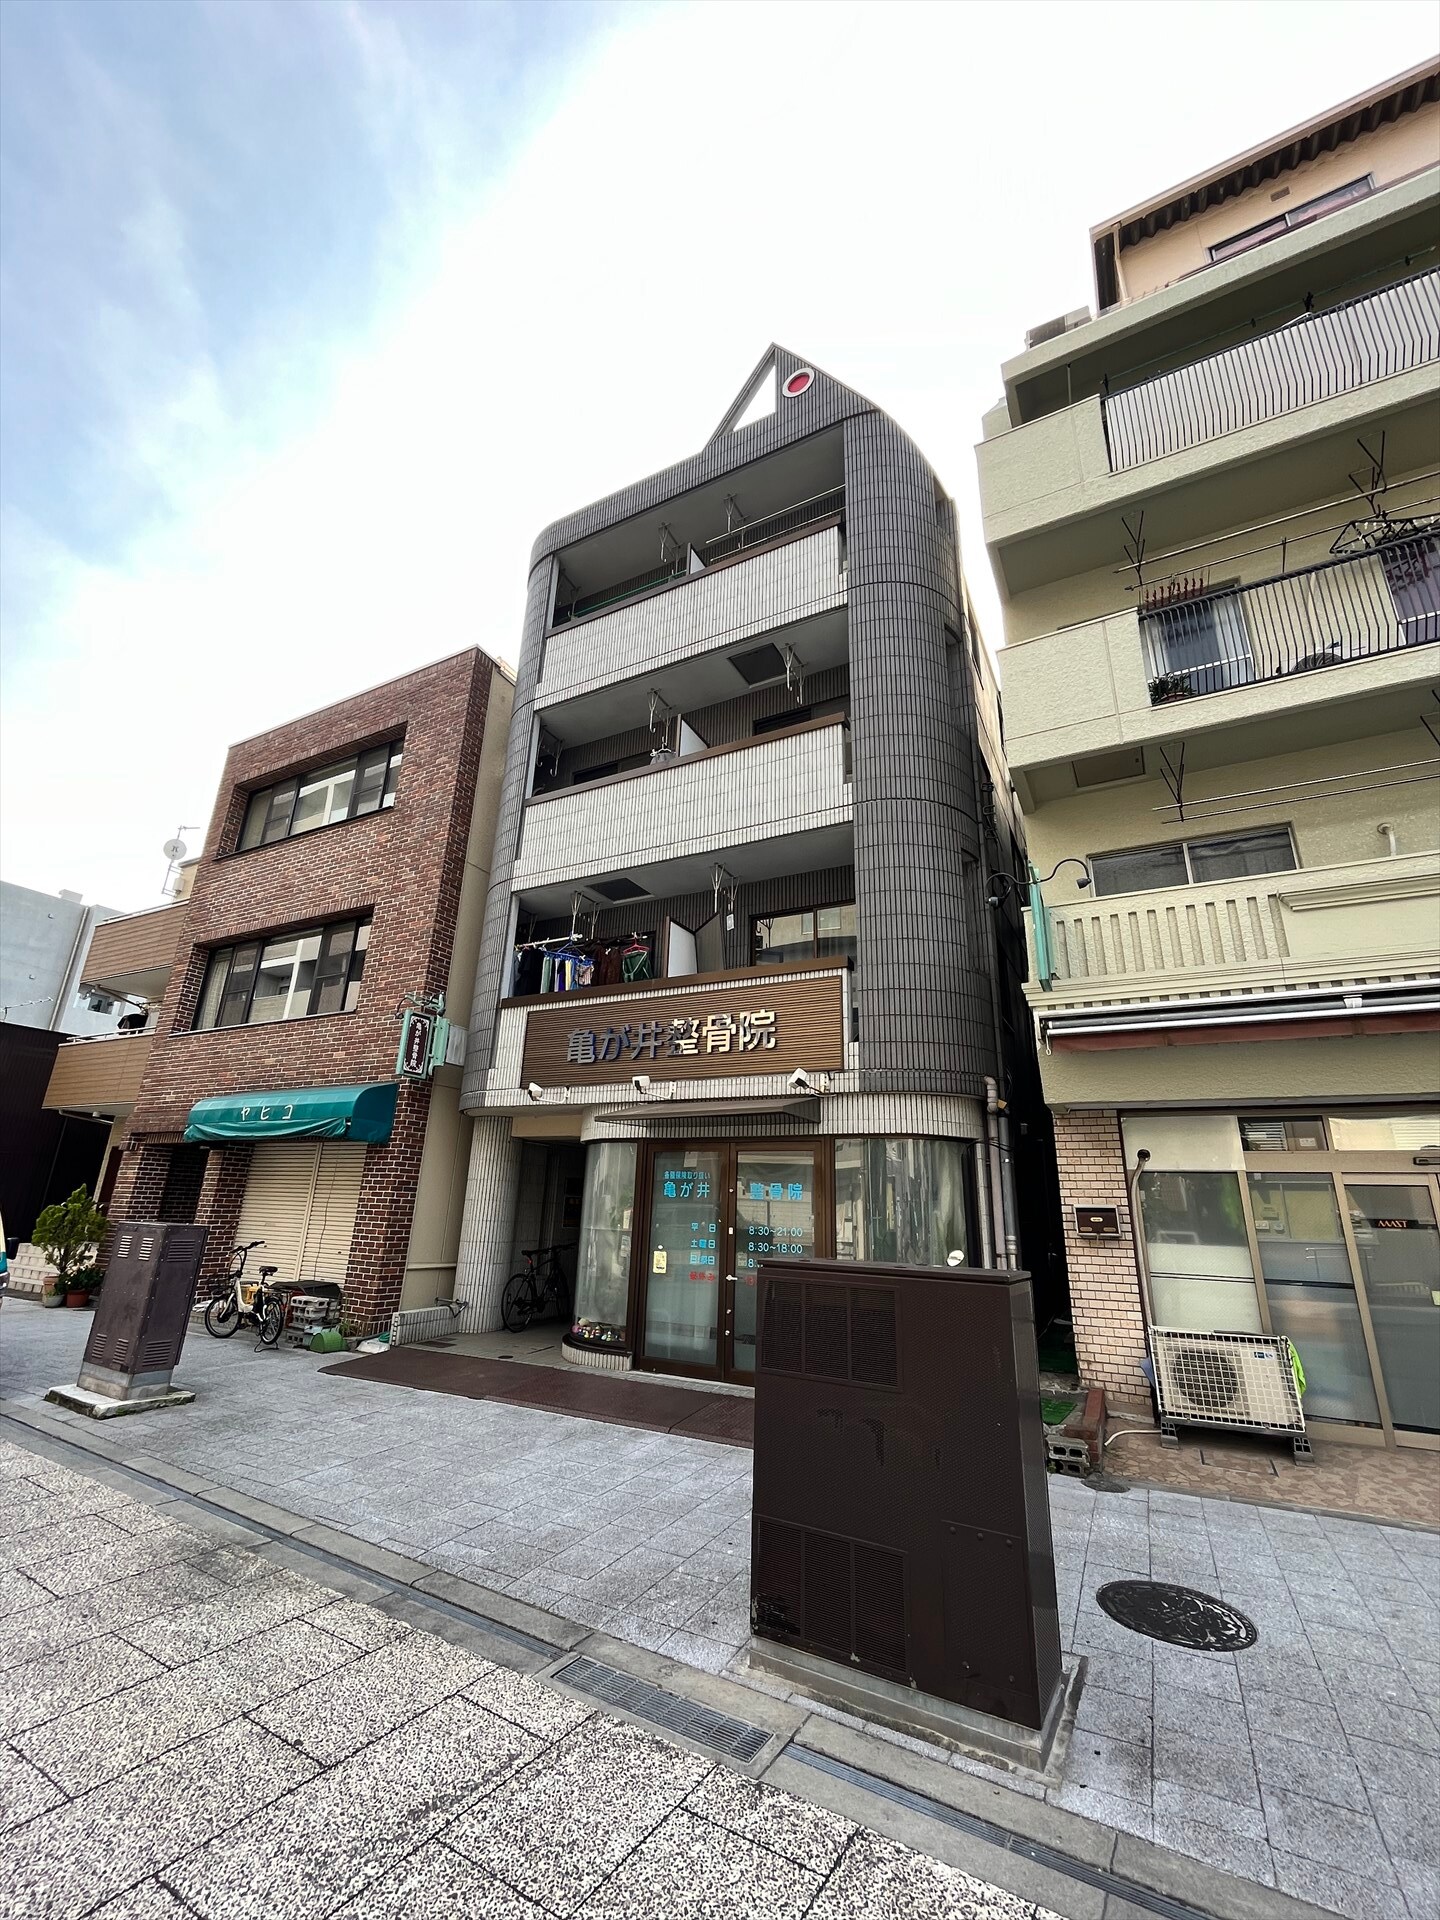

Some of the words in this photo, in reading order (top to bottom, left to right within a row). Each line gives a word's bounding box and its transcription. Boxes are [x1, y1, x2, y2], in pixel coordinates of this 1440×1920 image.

[567, 1009, 776, 1064] 亀が井整骨院
[241, 1104, 293, 1121] ヤヒコ
[664, 1181, 710, 1198] 亀が井
[750, 1183, 803, 1200] 整骨院
